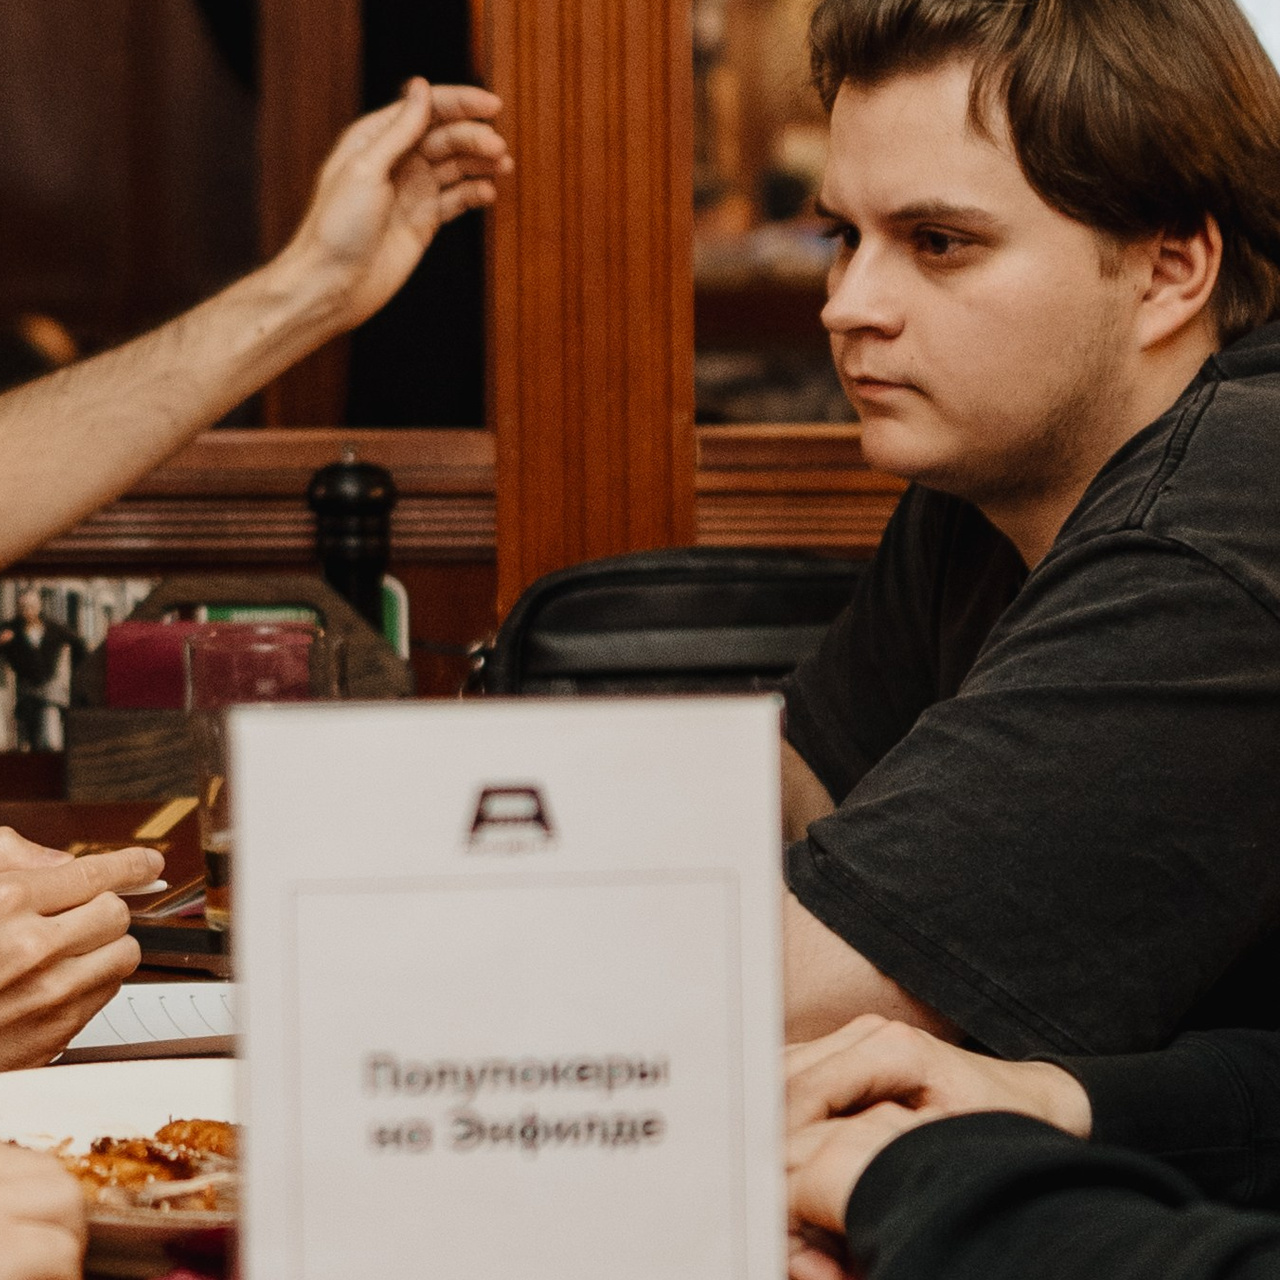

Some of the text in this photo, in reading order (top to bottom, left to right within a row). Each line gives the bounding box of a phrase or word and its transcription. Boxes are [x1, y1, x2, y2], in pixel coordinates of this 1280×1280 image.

[366, 1053, 668, 1098] Полупокеры
[370, 1109, 663, 1156] на Энфилде
